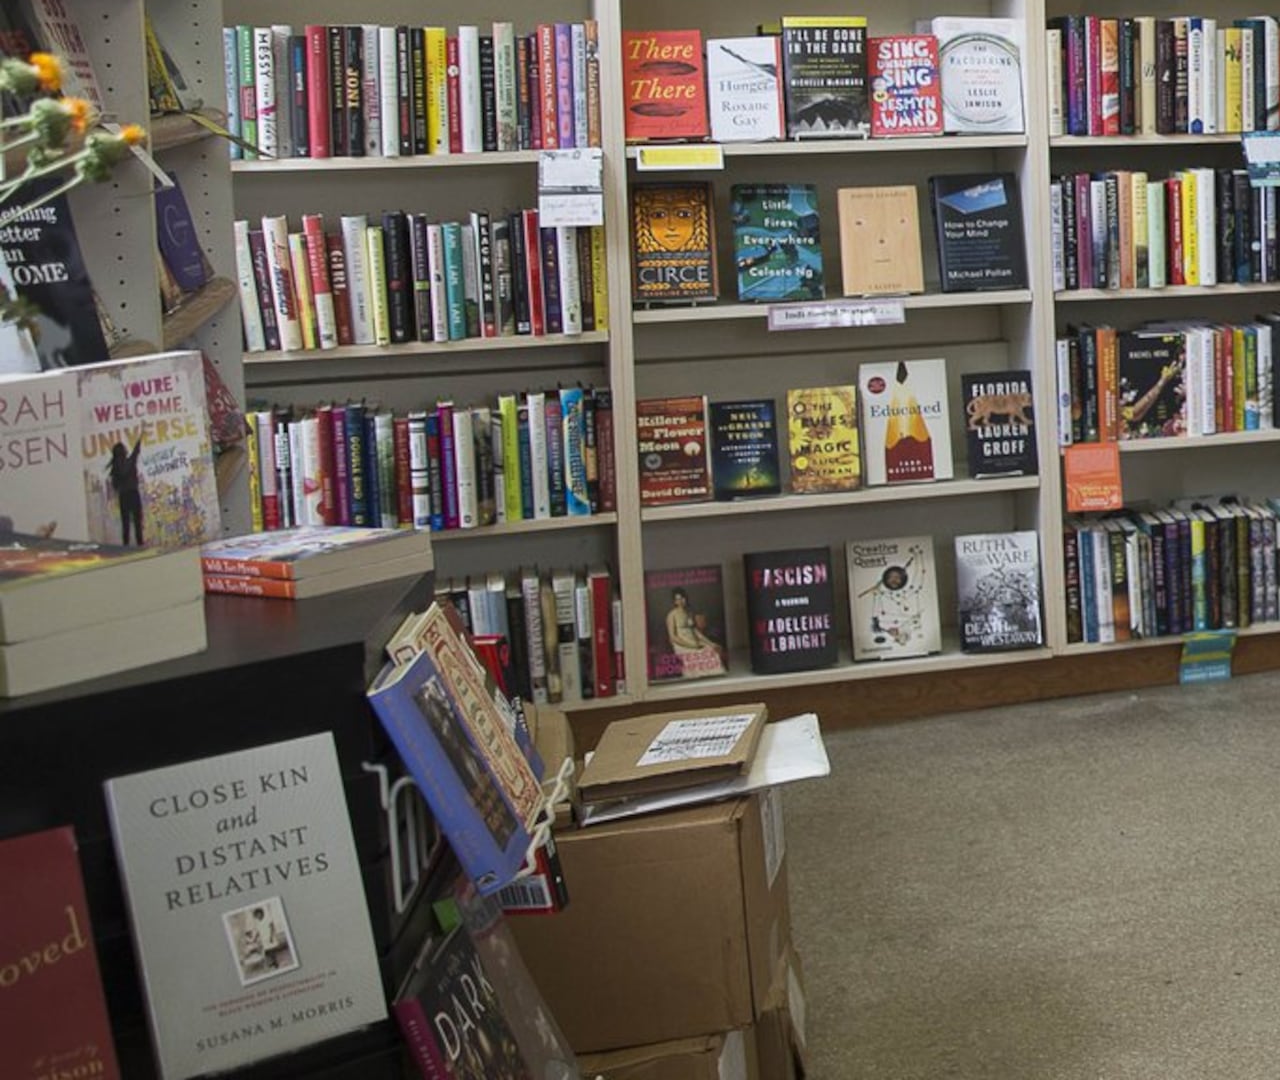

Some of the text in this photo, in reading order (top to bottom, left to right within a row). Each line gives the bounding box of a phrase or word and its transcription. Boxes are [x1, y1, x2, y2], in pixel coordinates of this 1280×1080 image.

[814, 30, 863, 41] BE GONE
[628, 38, 694, 60] There
[807, 43, 863, 54] THE DARK
[882, 69, 931, 86] SING
[631, 79, 697, 100] There
[719, 80, 769, 93] Hunger
[722, 101, 769, 112] Roxane
[965, 100, 1002, 108] JAMISON
[732, 114, 759, 127] Gay
[881, 110, 938, 128] WARD
[944, 219, 1009, 229] How Change
[966, 229, 988, 237] Mind
[743, 235, 815, 246] Everywhere
[640, 266, 710, 283] CIRCE
[948, 271, 983, 279] Michael
[972, 381, 1028, 397] FLORIDA
[870, 401, 941, 417] Educated
[638, 415, 687, 427] Killers
[654, 427, 704, 438] Flower
[977, 423, 1028, 439] LAUREN
[81, 419, 198, 459] UNIVERSE
[639, 442, 680, 453] Moon
[800, 441, 851, 454] MAGIC
[983, 441, 1025, 455] GROFF
[642, 486, 707, 499] David Grann
[961, 539, 1007, 553] RUTH
[985, 551, 1033, 564] WARE
[148, 765, 311, 820] CLOSE KIN
[215, 806, 259, 835] and
[175, 826, 310, 877] DISTANT
[165, 852, 331, 911] RELATIVES
[195, 1022, 267, 1053] SUSANA
[291, 995, 355, 1025] MORRIS
